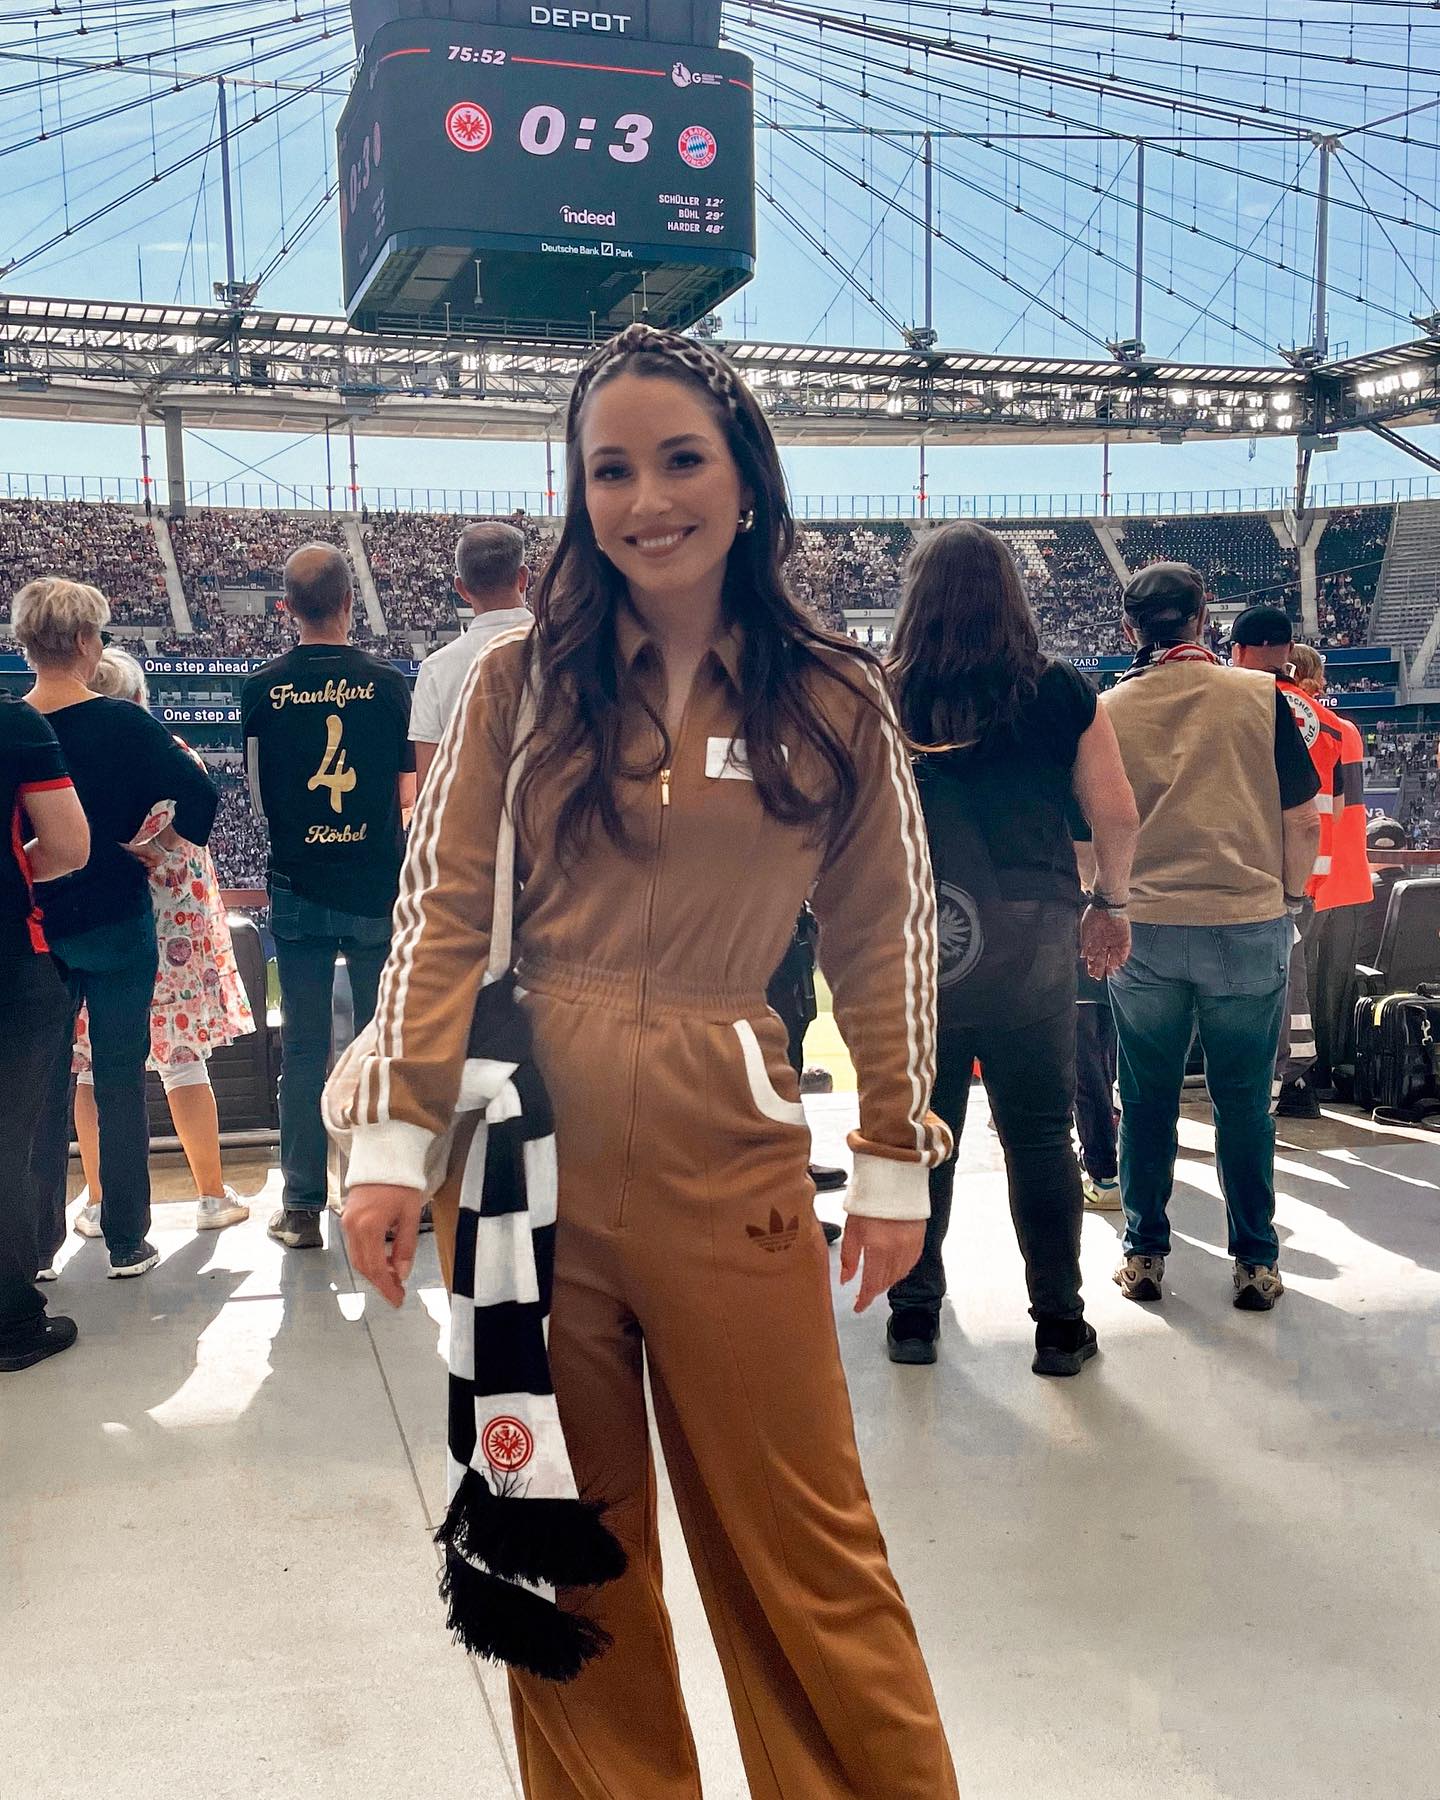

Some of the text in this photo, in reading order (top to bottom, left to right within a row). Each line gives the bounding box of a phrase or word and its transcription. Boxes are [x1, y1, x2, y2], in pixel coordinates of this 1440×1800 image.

[530, 6, 631, 33] DEPOT
[448, 46, 507, 65] 75:52
[658, 194, 700, 206] SCHÜLLER
[559, 205, 616, 226] indeed
[678, 208, 700, 219] BÜHL
[667, 221, 700, 233] HARDER
[541, 242, 633, 258] Deutsche Bank Park
[144, 660, 172, 672] One
[175, 660, 205, 674] step
[208, 661, 249, 673] ahead
[1069, 658, 1099, 667] ZARD
[269, 679, 375, 710] Frankfurt
[164, 708, 191, 721] One
[194, 709, 224, 723] step
[1285, 694, 1314, 719] SCHES
[1304, 724, 1316, 743] EUZ
[307, 714, 357, 814] 4
[304, 823, 368, 844] Körbel
